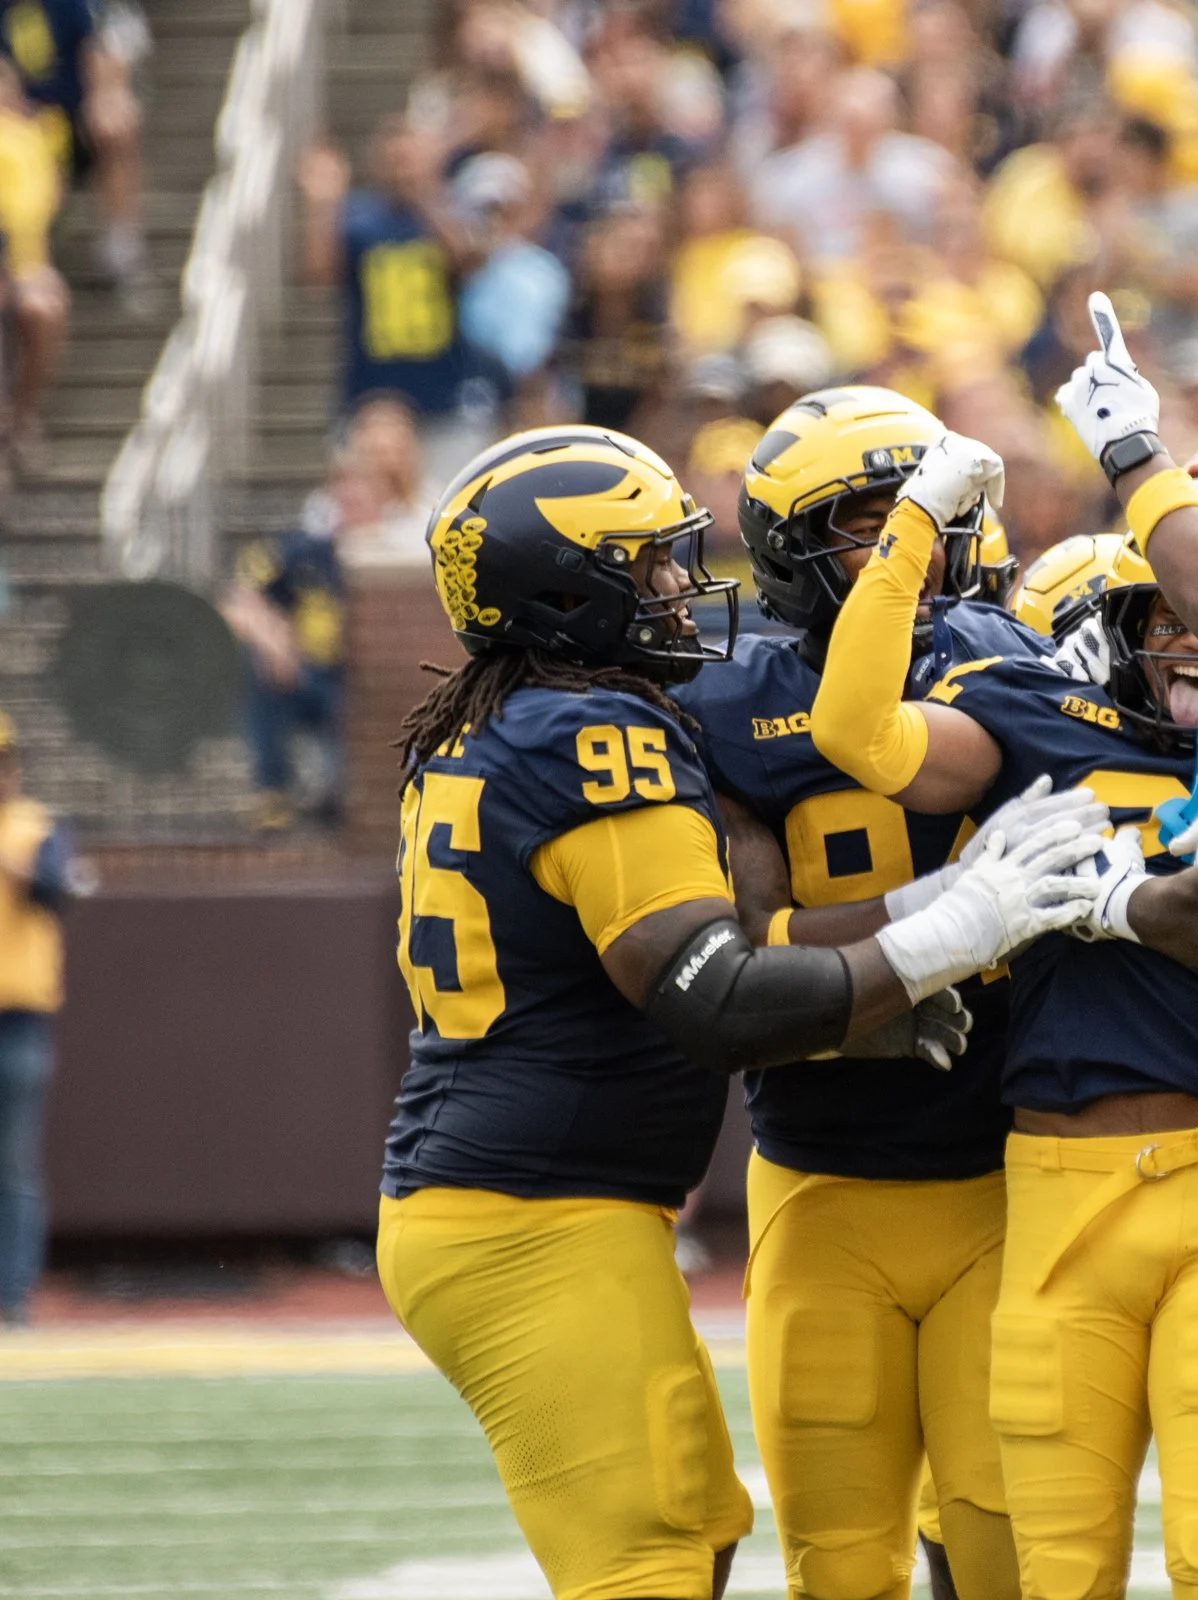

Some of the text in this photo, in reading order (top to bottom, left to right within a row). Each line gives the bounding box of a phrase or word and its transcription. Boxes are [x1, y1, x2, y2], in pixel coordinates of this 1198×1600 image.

[890, 446, 916, 464] M
[576, 724, 676, 805] 95
[678, 928, 735, 988] Mueller
